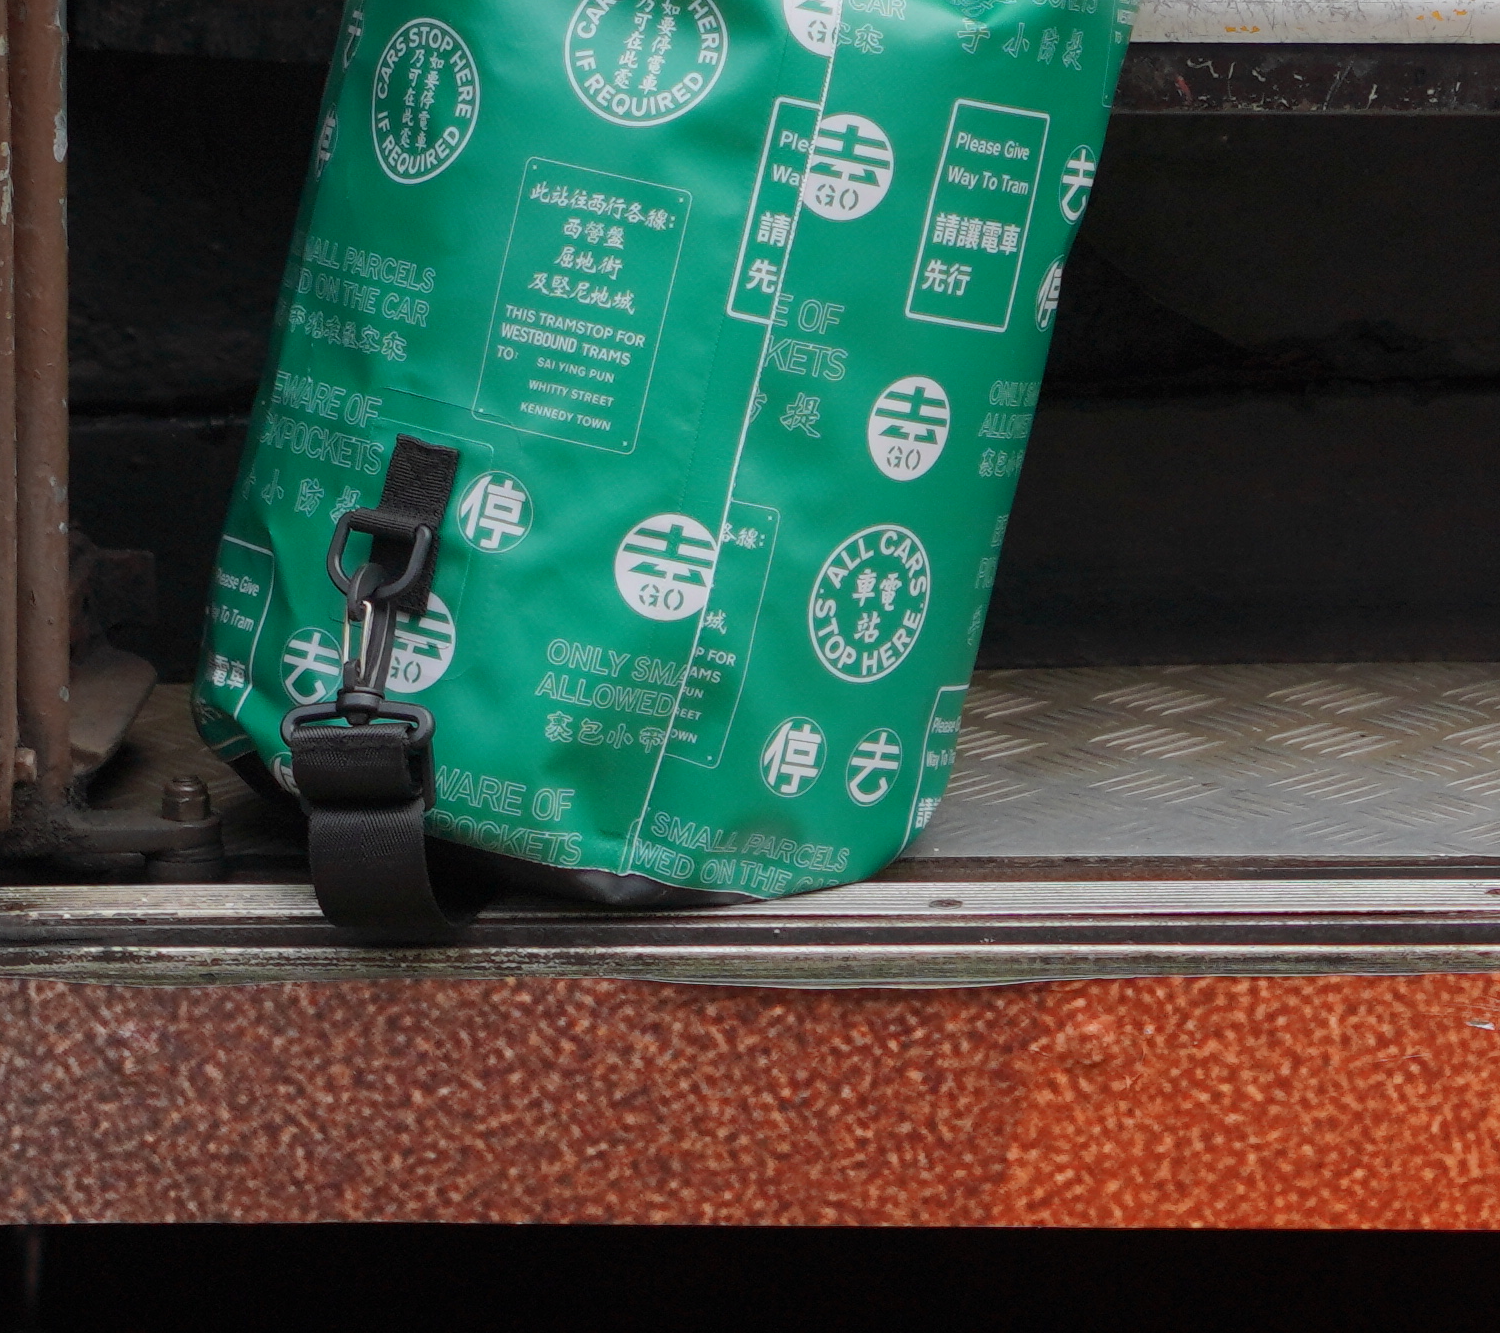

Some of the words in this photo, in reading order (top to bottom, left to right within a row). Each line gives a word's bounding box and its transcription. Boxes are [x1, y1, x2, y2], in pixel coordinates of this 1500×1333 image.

[377, 37, 407, 99] CARS
[409, 27, 453, 53] STOP
[450, 50, 473, 119] HERE
[575, 50, 596, 71] IF
[584, 72, 703, 116] REQUIRED
[378, 111, 390, 132] IF
[382, 126, 460, 174] REQUIRED
[956, 132, 1001, 156] Please
[1004, 141, 1030, 161] Give
[815, 183, 859, 211] GO
[947, 165, 976, 190] Way
[982, 173, 997, 190] To
[1001, 175, 1029, 196] Tram
[343, 246, 436, 293] PARCELS
[922, 259, 972, 297] 先行
[344, 280, 380, 314] THE
[382, 293, 429, 327] CAR
[798, 299, 844, 334] OF
[502, 322, 577, 353] WESTBOUND
[582, 342, 631, 366] TRAMS
[505, 304, 536, 323] THIS
[539, 312, 614, 339] TRAMSTOP
[616, 330, 646, 348] FOR
[537, 356, 556, 370] SAI
[558, 361, 586, 377] YING
[589, 368, 615, 383] PUN
[344, 393, 382, 428] OF
[529, 379, 569, 398] WHITTY
[571, 389, 614, 408] STREET
[520, 401, 574, 422] KENNEDY
[576, 414, 611, 431] TOWN
[886, 446, 921, 471] GO
[461, 475, 527, 548] 停
[825, 537, 874, 589] ALL
[880, 531, 927, 597] CARS
[638, 583, 685, 612] GO
[815, 598, 857, 669] STOP
[862, 609, 921, 676] HERE
[546, 638, 630, 677] ONLY
[707, 649, 736, 666] FOR
[535, 672, 677, 717] ALLOWED
[764, 721, 822, 793] 停
[532, 788, 575, 822] OF
[651, 810, 740, 853] SMALL
[742, 833, 850, 873] PARCELS
[701, 858, 738, 885] ON
[740, 862, 792, 894] THE
